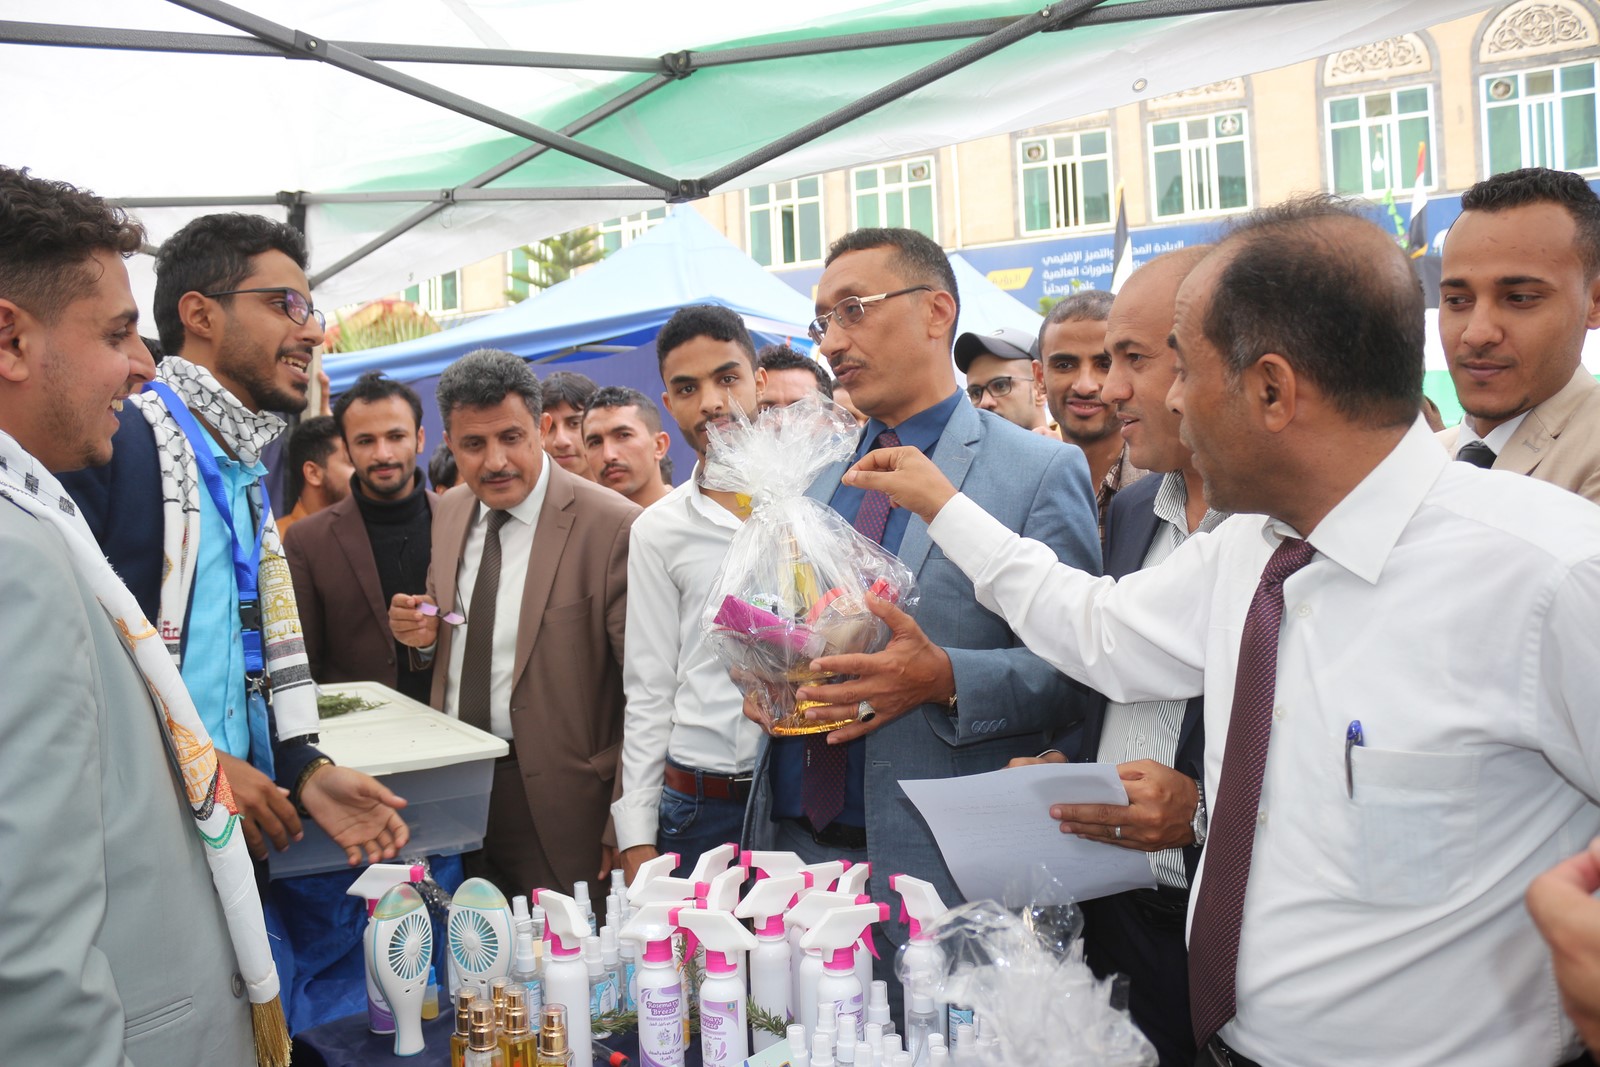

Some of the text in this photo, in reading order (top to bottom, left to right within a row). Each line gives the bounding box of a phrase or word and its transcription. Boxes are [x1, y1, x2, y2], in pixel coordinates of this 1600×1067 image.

[1042, 266, 1079, 282] العالمية
[646, 999, 679, 1009] Rosemary
[651, 1007, 676, 1016] Breeze
